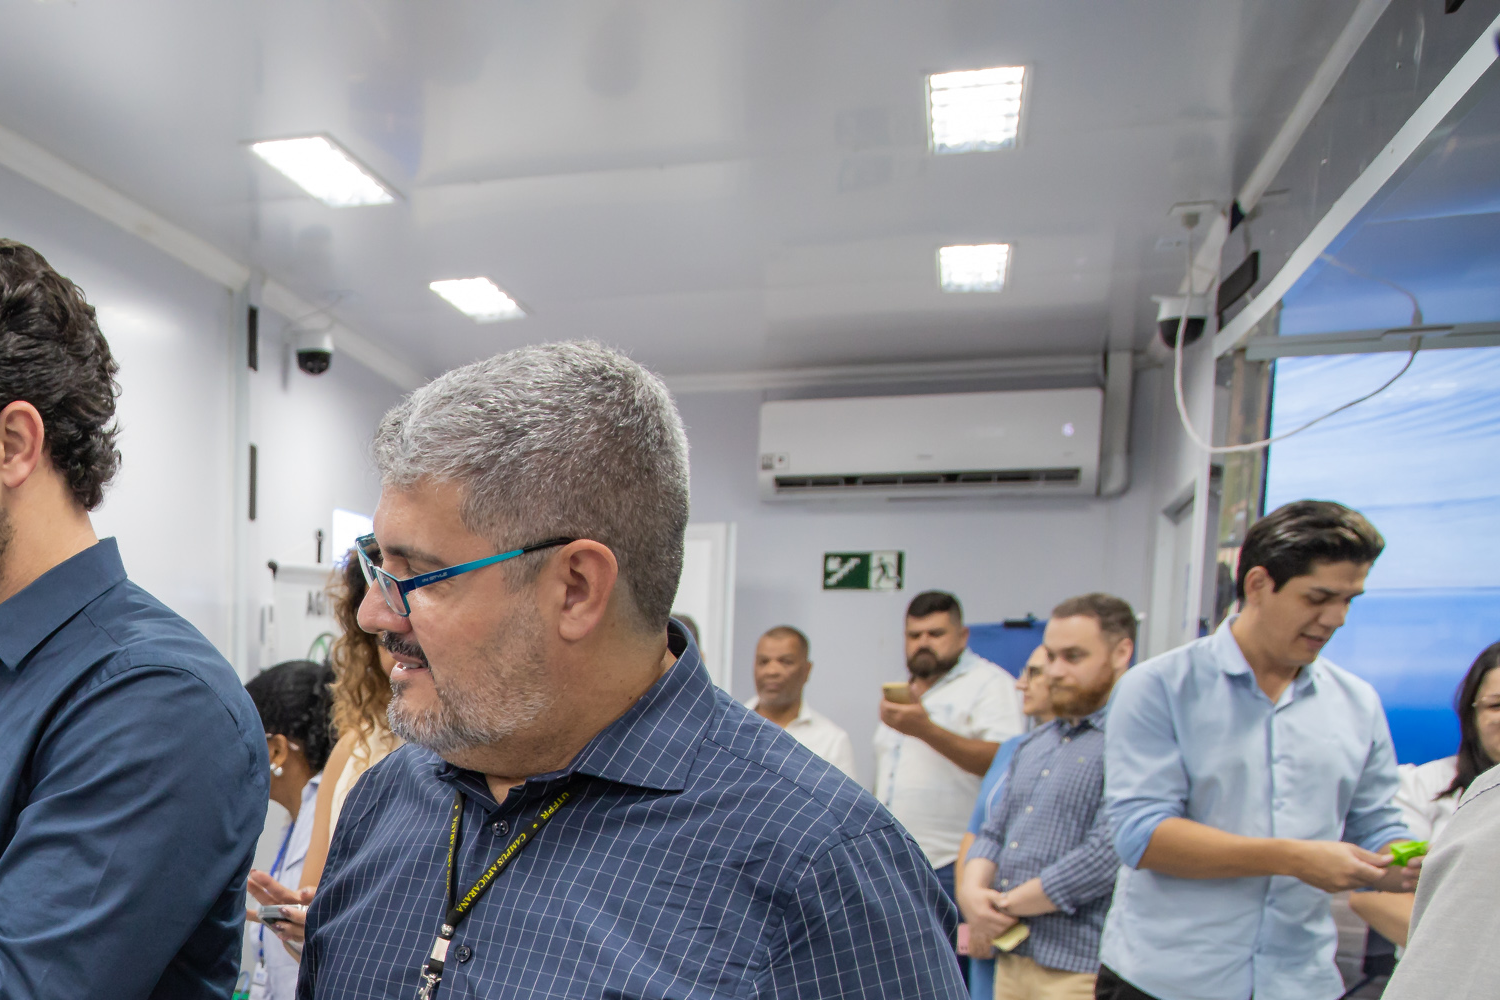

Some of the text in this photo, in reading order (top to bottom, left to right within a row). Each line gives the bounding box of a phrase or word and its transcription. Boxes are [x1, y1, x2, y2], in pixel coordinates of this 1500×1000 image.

[539, 790, 570, 820] UTFPR
[455, 831, 528, 914] CAMPUS APUCARANA
